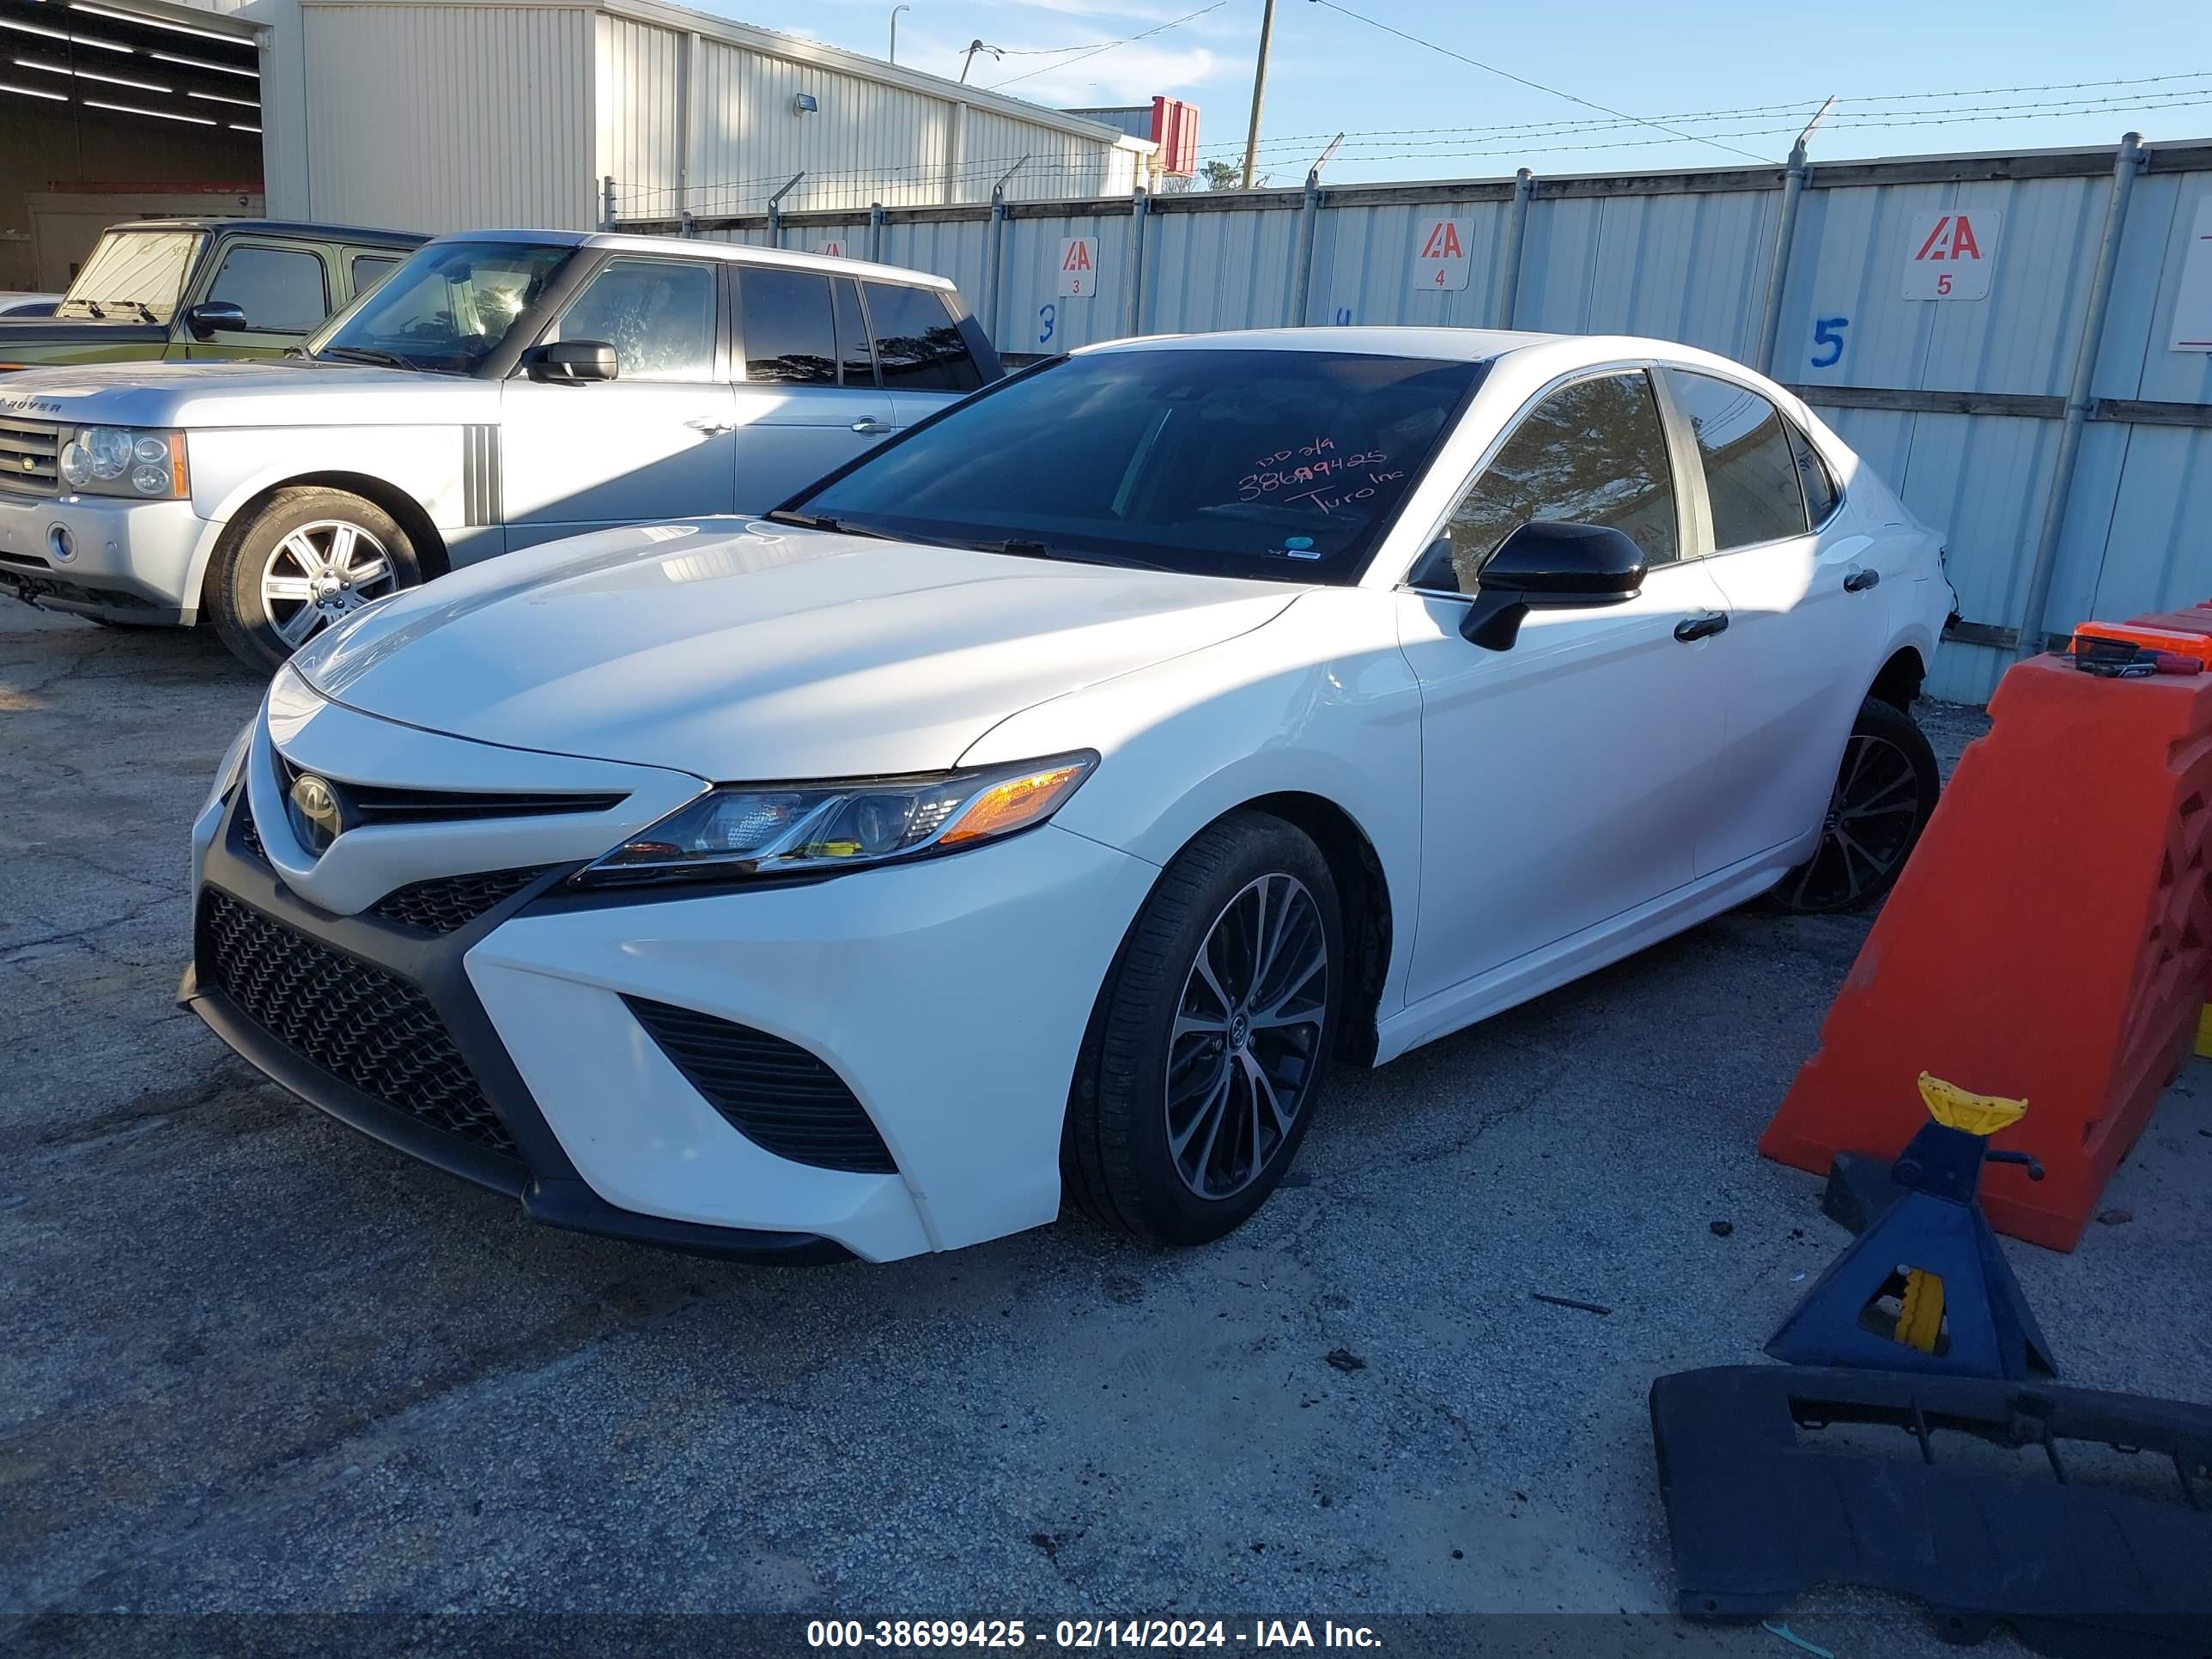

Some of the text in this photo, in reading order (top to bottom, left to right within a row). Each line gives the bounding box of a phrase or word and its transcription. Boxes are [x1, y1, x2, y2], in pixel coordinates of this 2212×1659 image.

[1073, 280, 1080, 294] 3
[1435, 270, 1445, 286] 4
[1937, 275, 1953, 295] 5
[1039, 304, 1055, 343] 3
[1811, 318, 1849, 368] 5
[8, 400, 62, 413] ROVER
[1284, 485, 1375, 514] Turo
